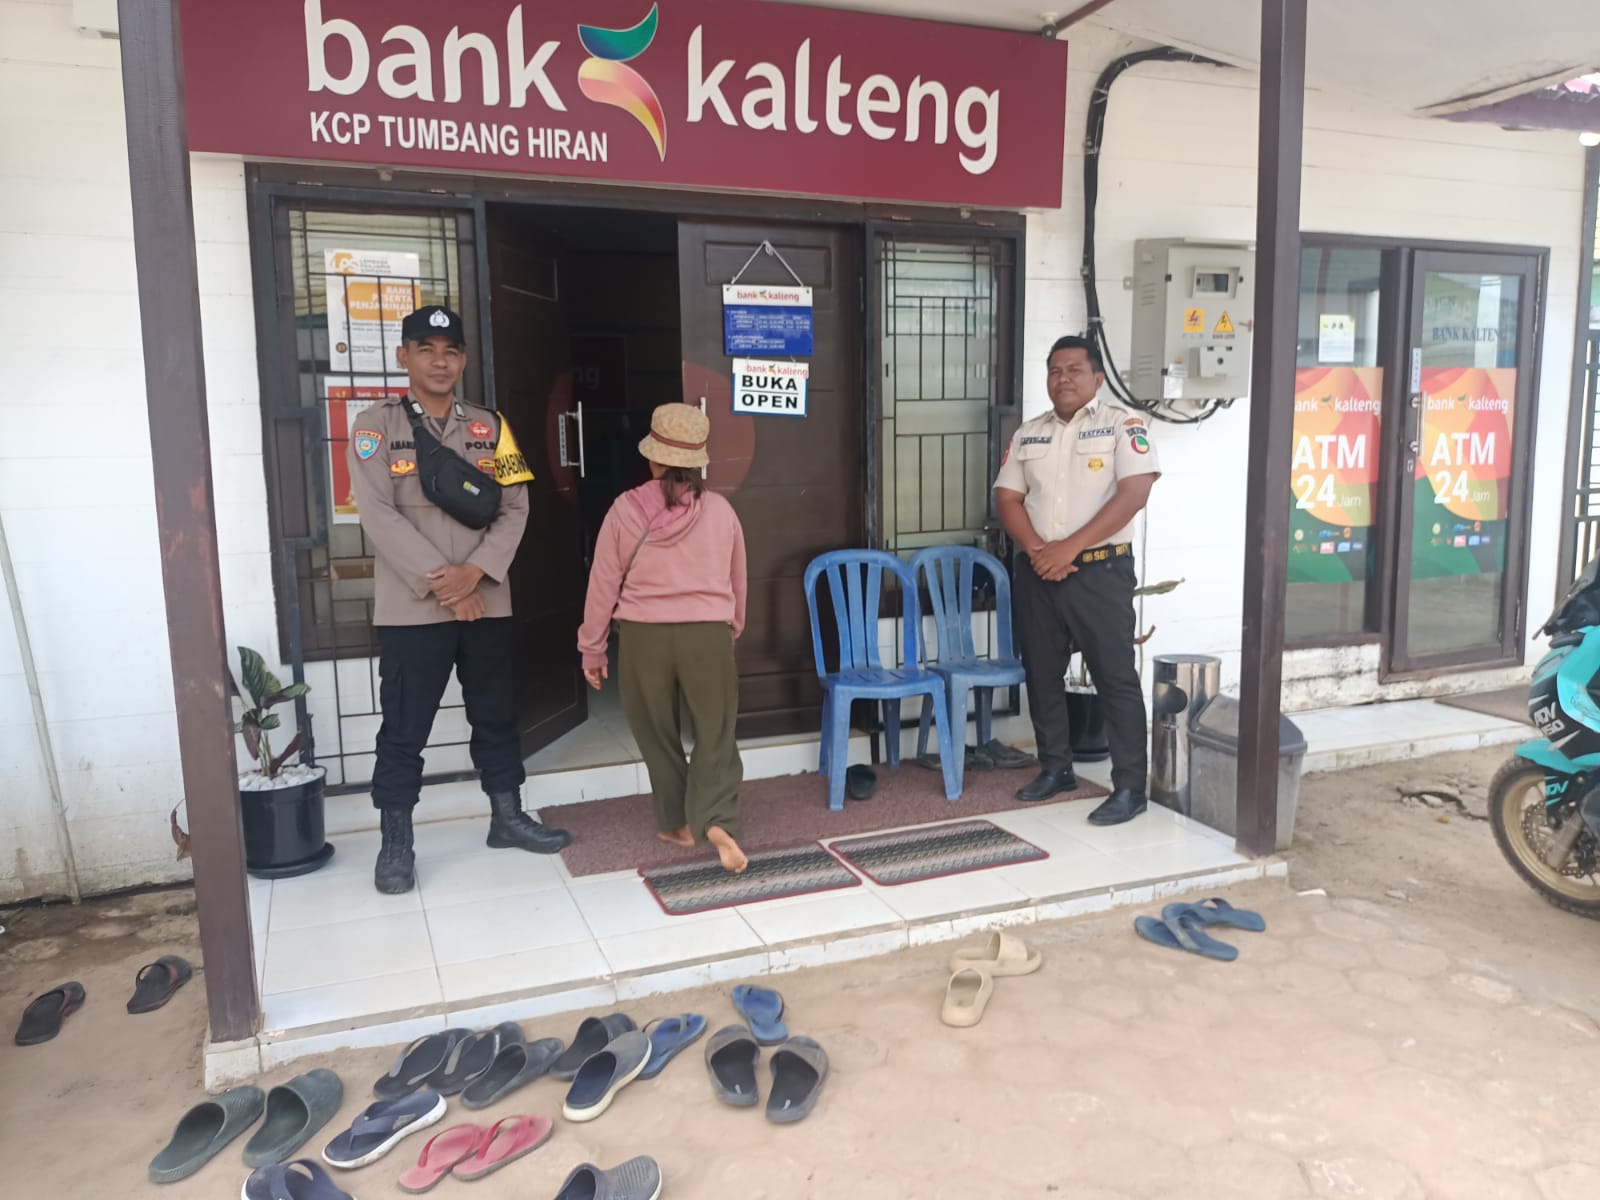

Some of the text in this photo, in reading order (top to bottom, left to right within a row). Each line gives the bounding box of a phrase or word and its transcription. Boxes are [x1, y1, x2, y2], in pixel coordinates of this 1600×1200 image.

[304, 0, 1000, 175] bank kalteng
[310, 111, 608, 163] KCP TUMBANG HIRAN
[737, 291, 758, 299] bank
[1432, 327, 1459, 341] BANK
[746, 364, 767, 373] bank
[742, 374, 798, 391] BUKA
[742, 393, 798, 409] OPEN
[1295, 396, 1381, 416] ank kalteng
[1427, 395, 1509, 415] bank kalteng
[1292, 434, 1366, 470] ATM
[1430, 431, 1496, 467] ATM
[1296, 474, 1336, 509] 24
[1434, 469, 1469, 504] 24
